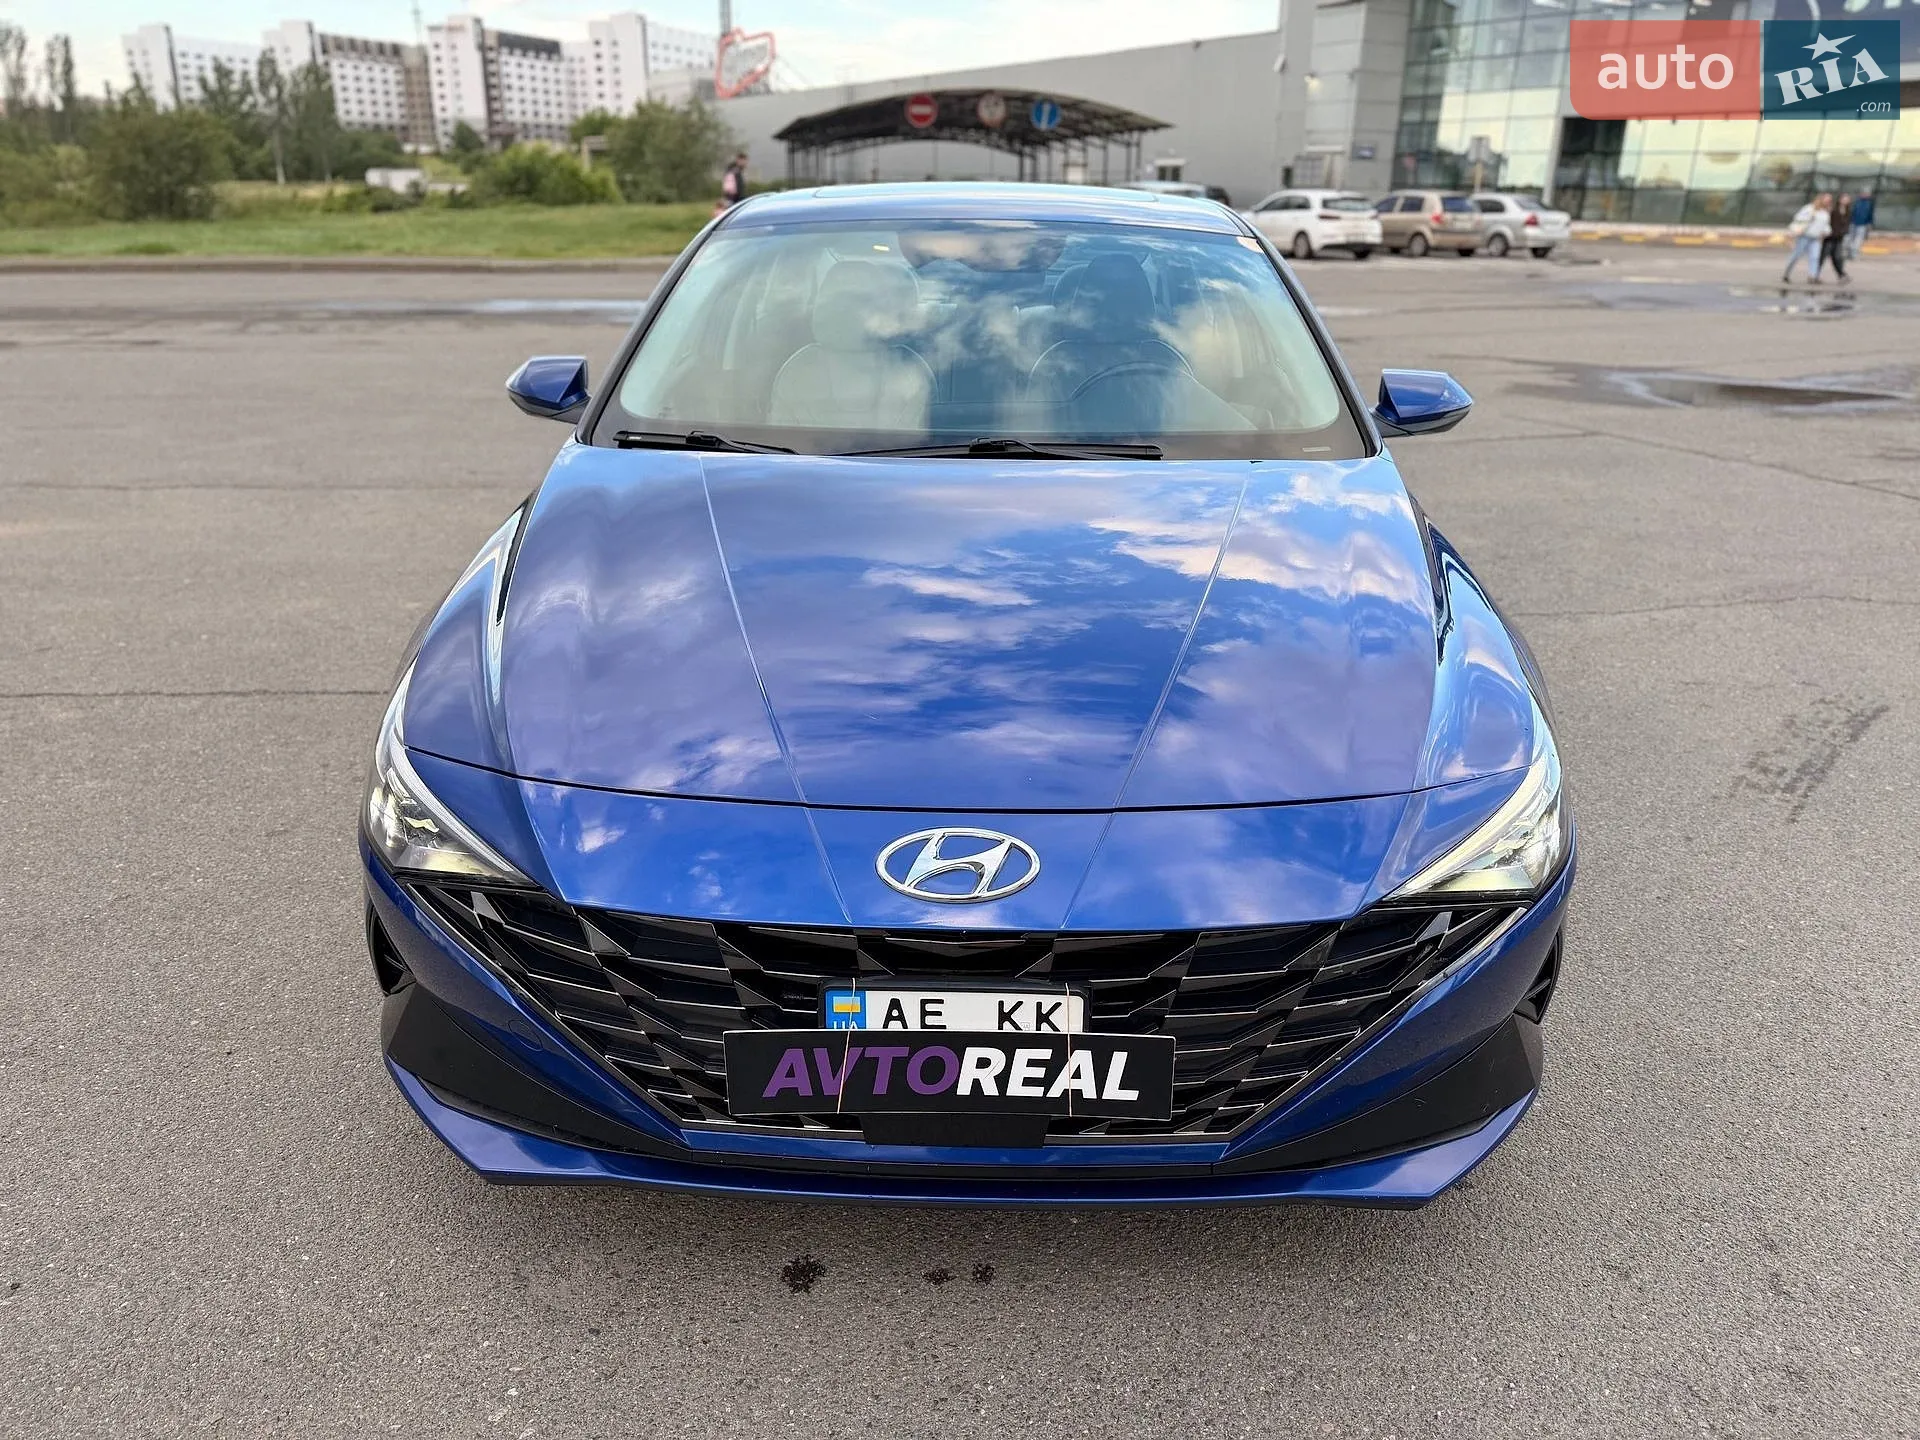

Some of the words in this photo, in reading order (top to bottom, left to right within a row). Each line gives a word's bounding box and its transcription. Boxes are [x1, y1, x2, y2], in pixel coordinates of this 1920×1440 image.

[882, 997, 947, 1030] AE
[998, 999, 1063, 1032] KK
[762, 1045, 1140, 1102] AVTOREAL
